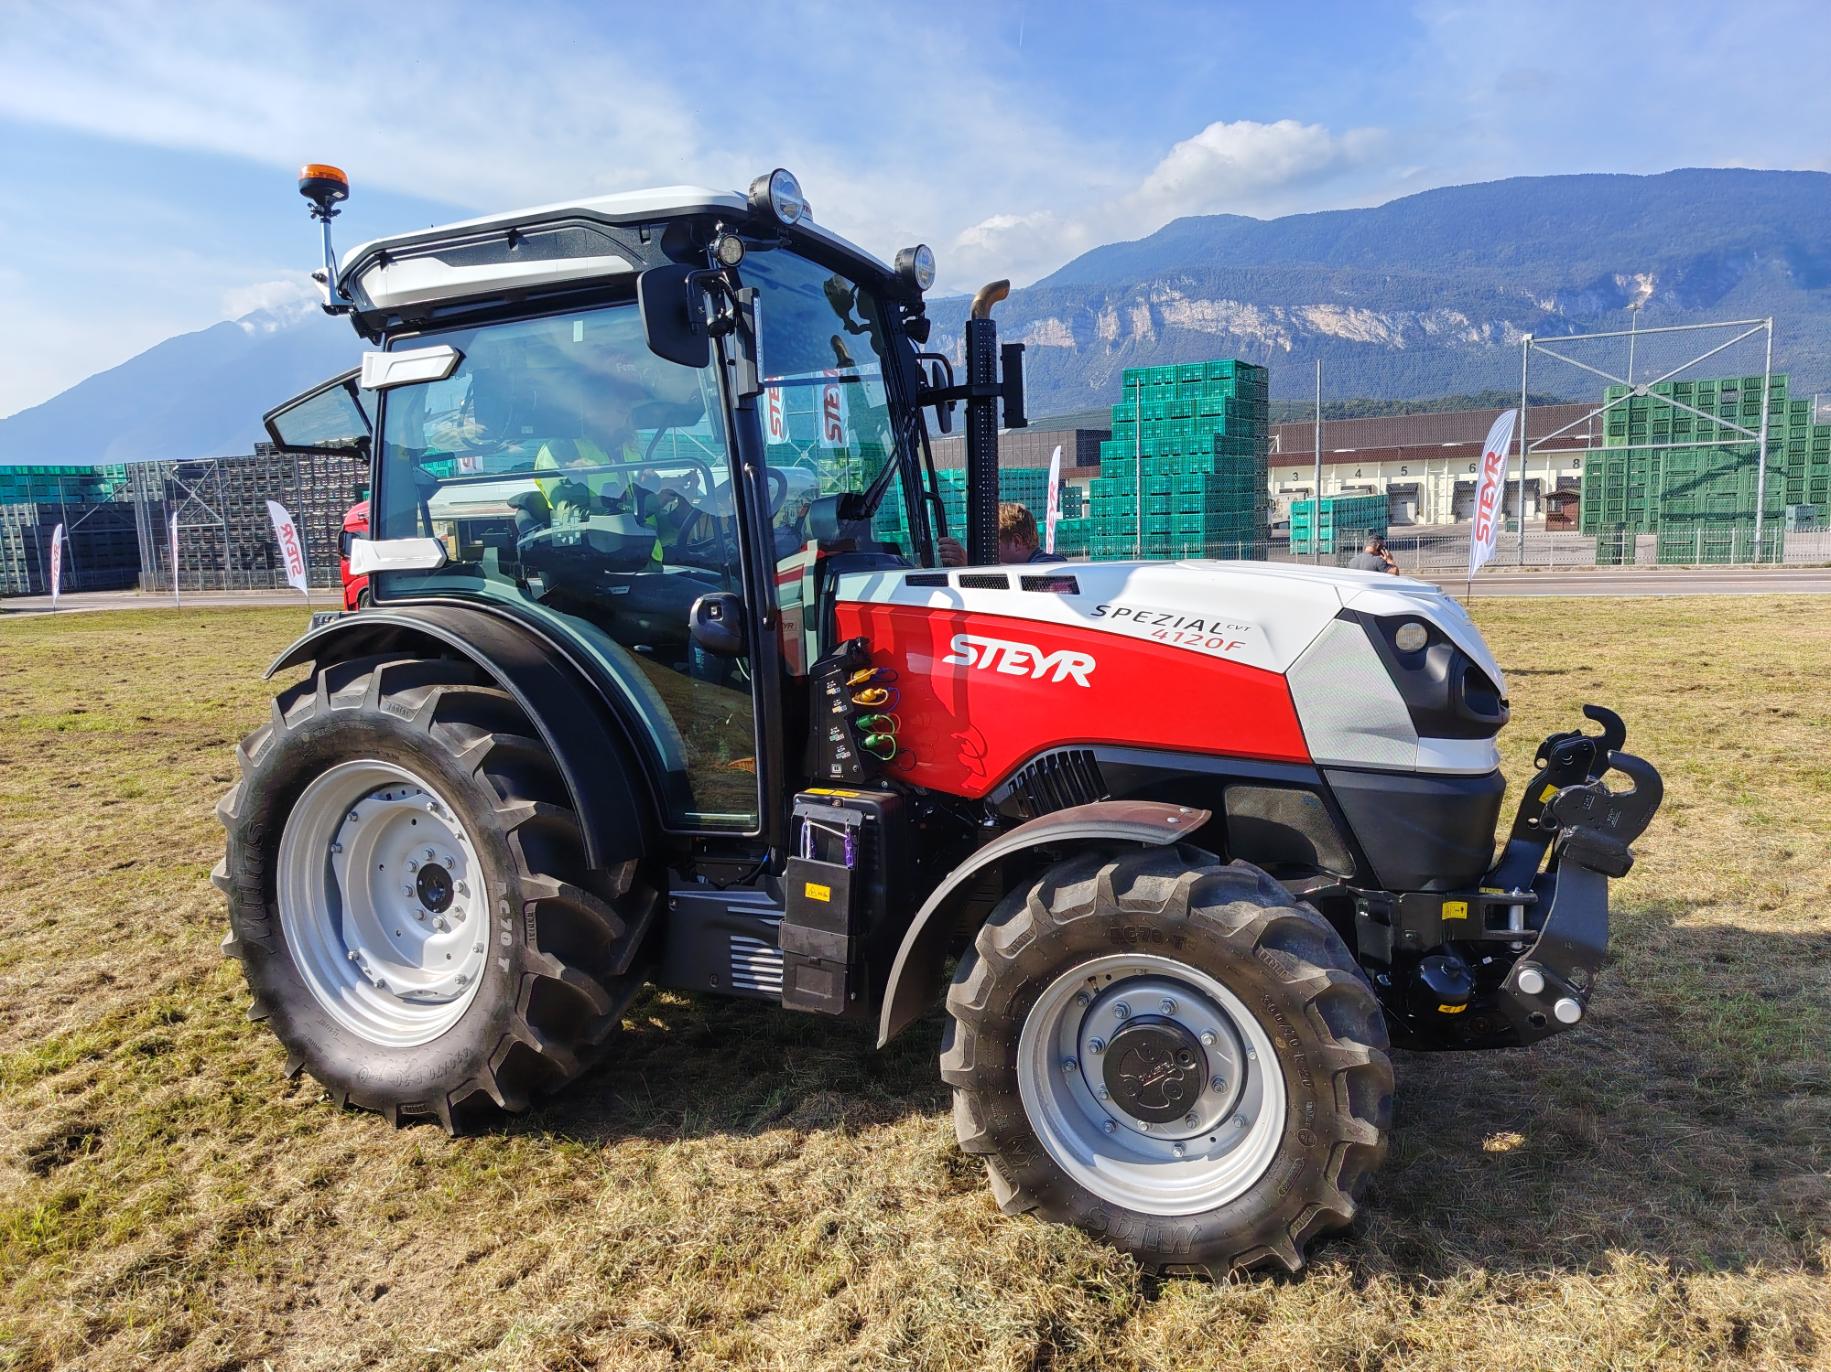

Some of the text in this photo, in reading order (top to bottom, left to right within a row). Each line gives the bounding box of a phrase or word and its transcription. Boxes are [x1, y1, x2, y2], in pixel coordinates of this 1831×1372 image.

[1401, 465, 1408, 476] 5
[1469, 463, 1476, 473] 6
[1573, 458, 1580, 469] 8
[1292, 472, 1299, 482] 3
[1355, 469, 1362, 478] 4
[1476, 451, 1502, 545] STEYR
[1090, 604, 1252, 635] SPEZIAL CVT
[1151, 628, 1246, 651] 4120F
[942, 633, 1097, 687] STEYR
[496, 881, 512, 946] AC70
